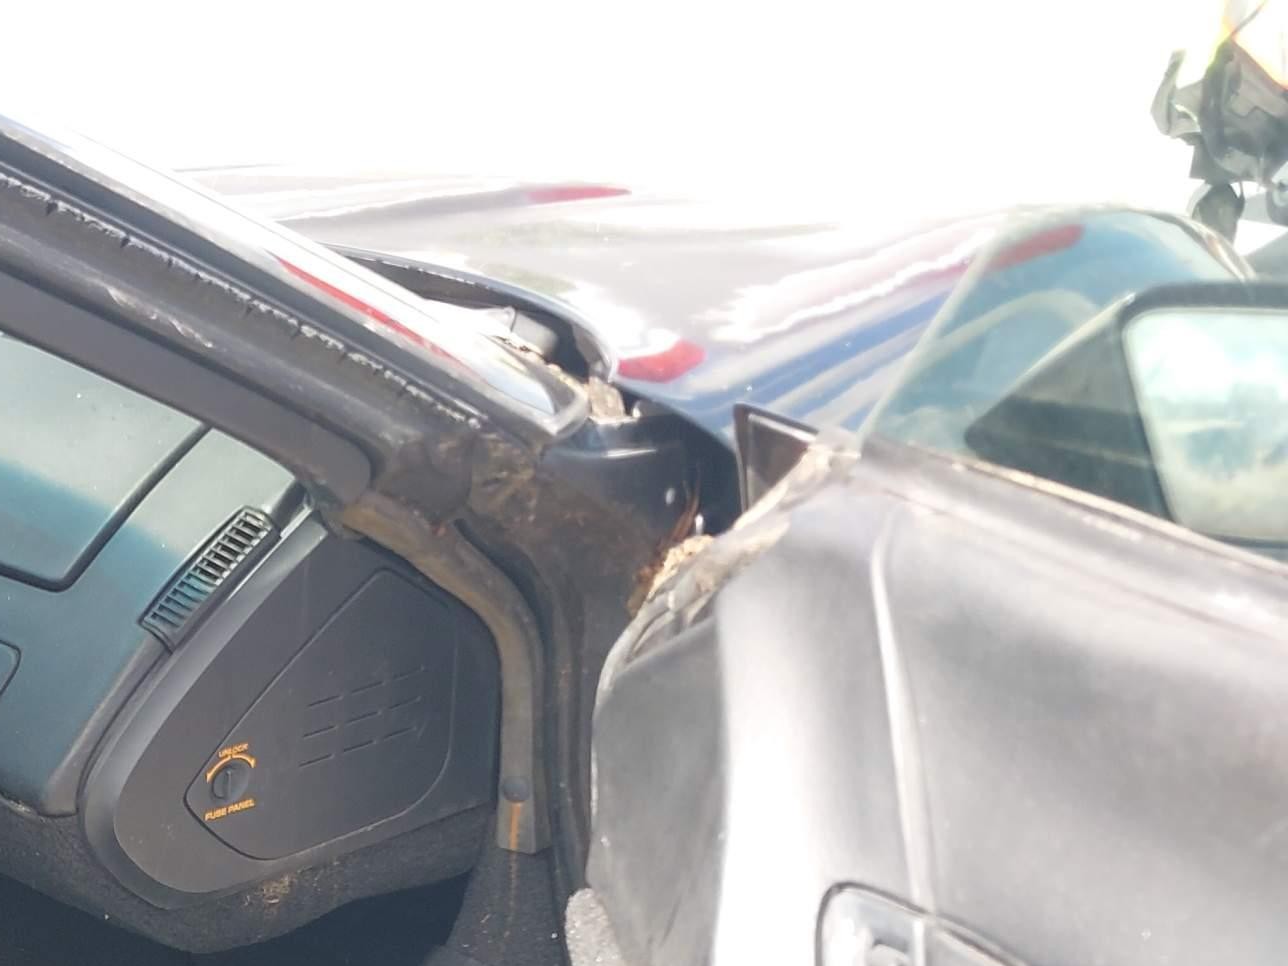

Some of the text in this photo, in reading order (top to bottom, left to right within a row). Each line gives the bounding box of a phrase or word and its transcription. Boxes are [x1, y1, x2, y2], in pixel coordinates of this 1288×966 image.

[218, 743, 249, 758] UNLOCK
[205, 799, 254, 820] FUSE PANEL
